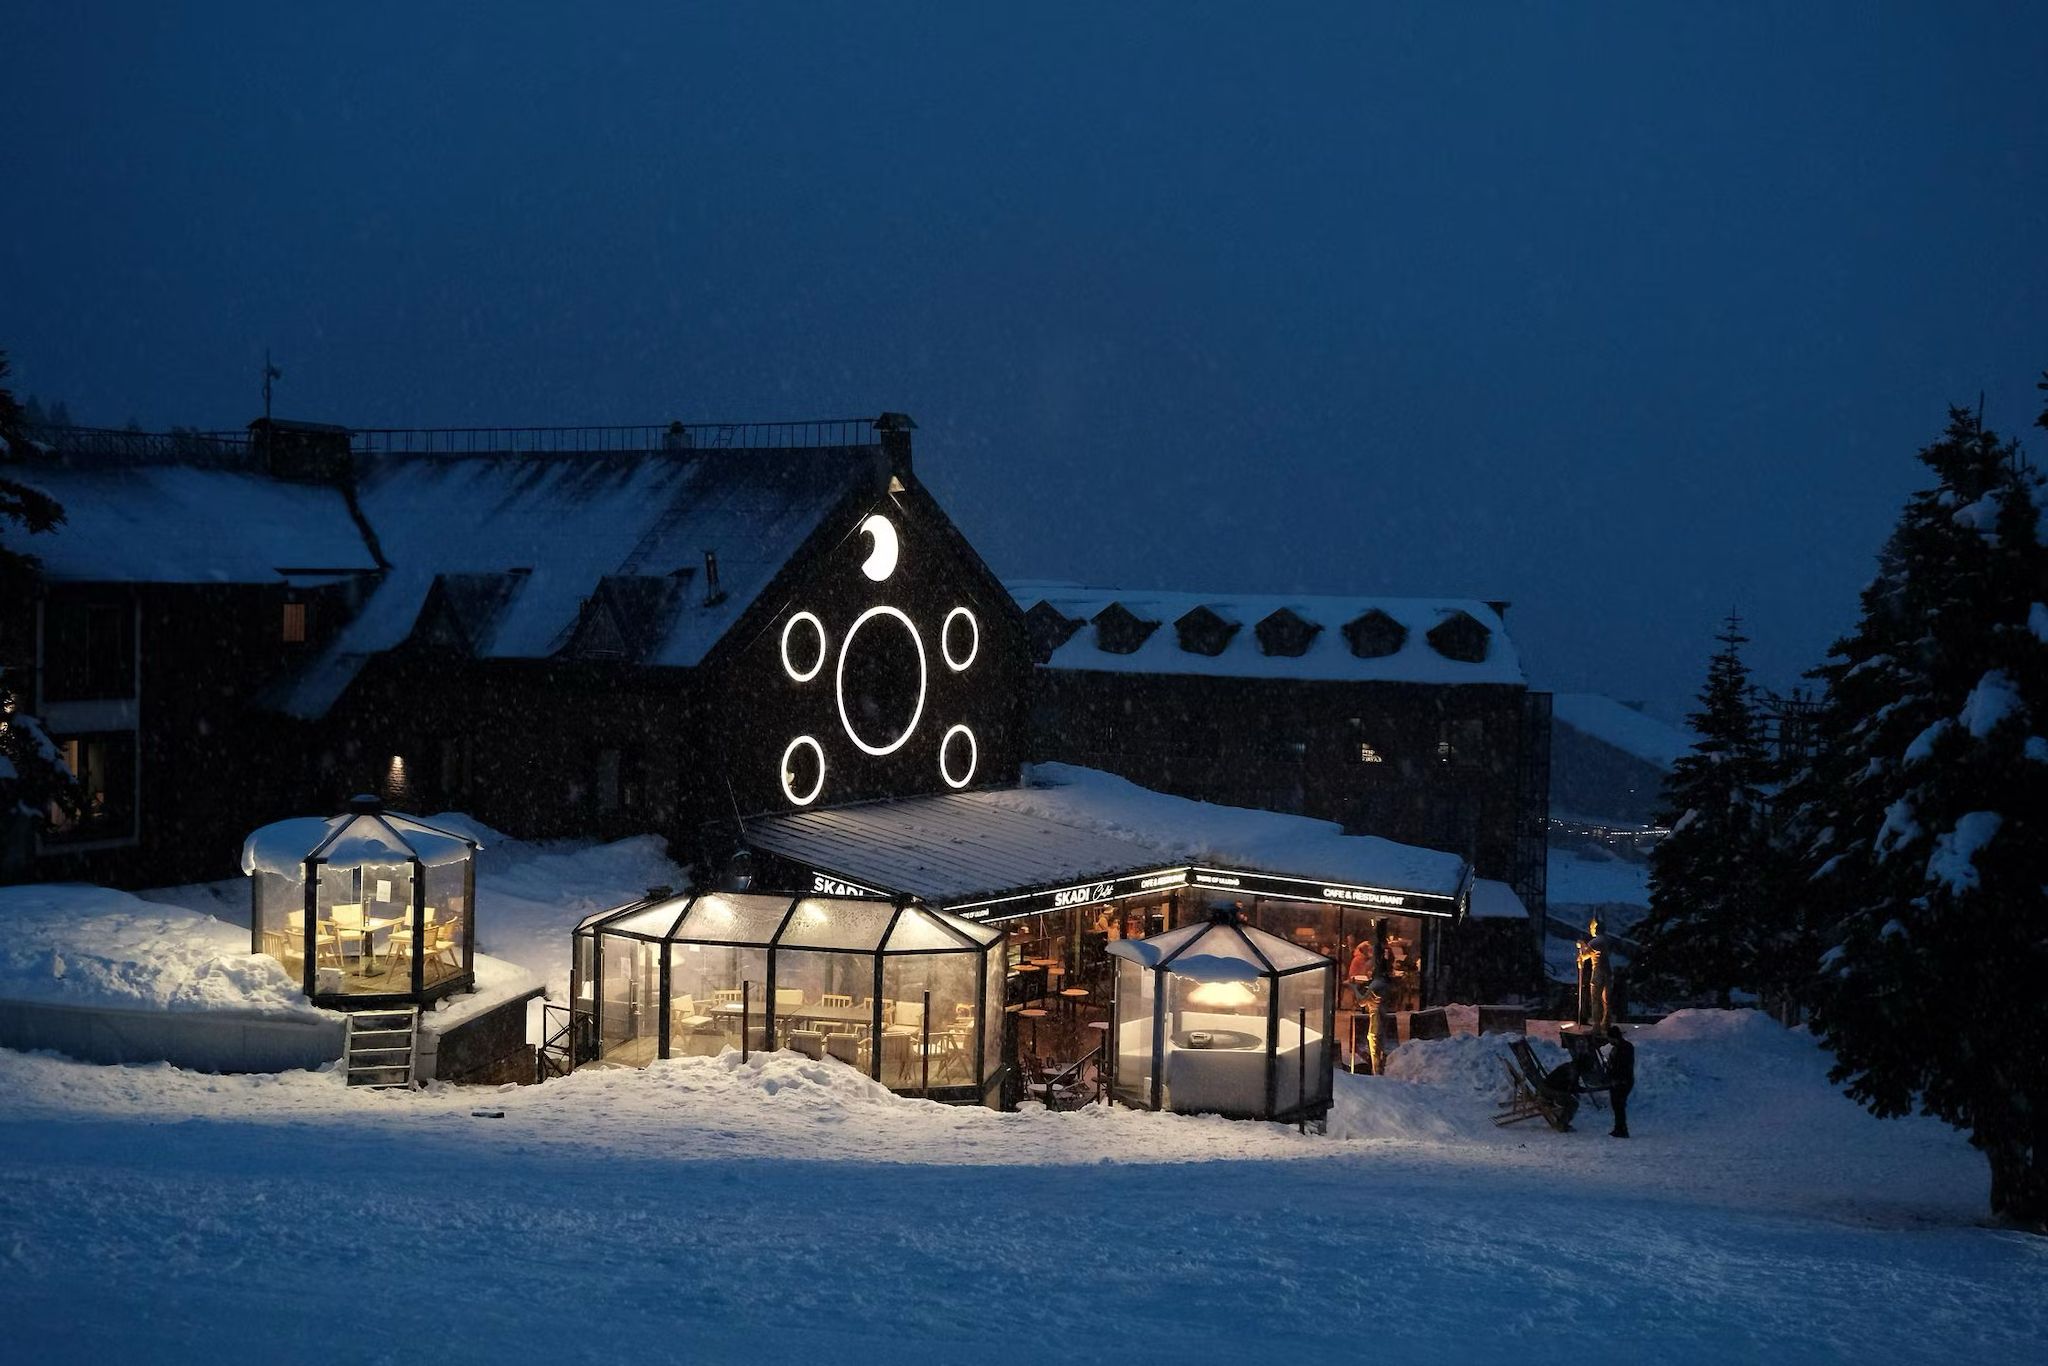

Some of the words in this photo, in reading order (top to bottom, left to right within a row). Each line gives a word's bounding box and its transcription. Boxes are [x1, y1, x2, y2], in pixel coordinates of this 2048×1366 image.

[1055, 887, 1090, 906] SKADI
[1345, 891, 1352, 899] &
[1352, 892, 1404, 905] RESTAURANT
